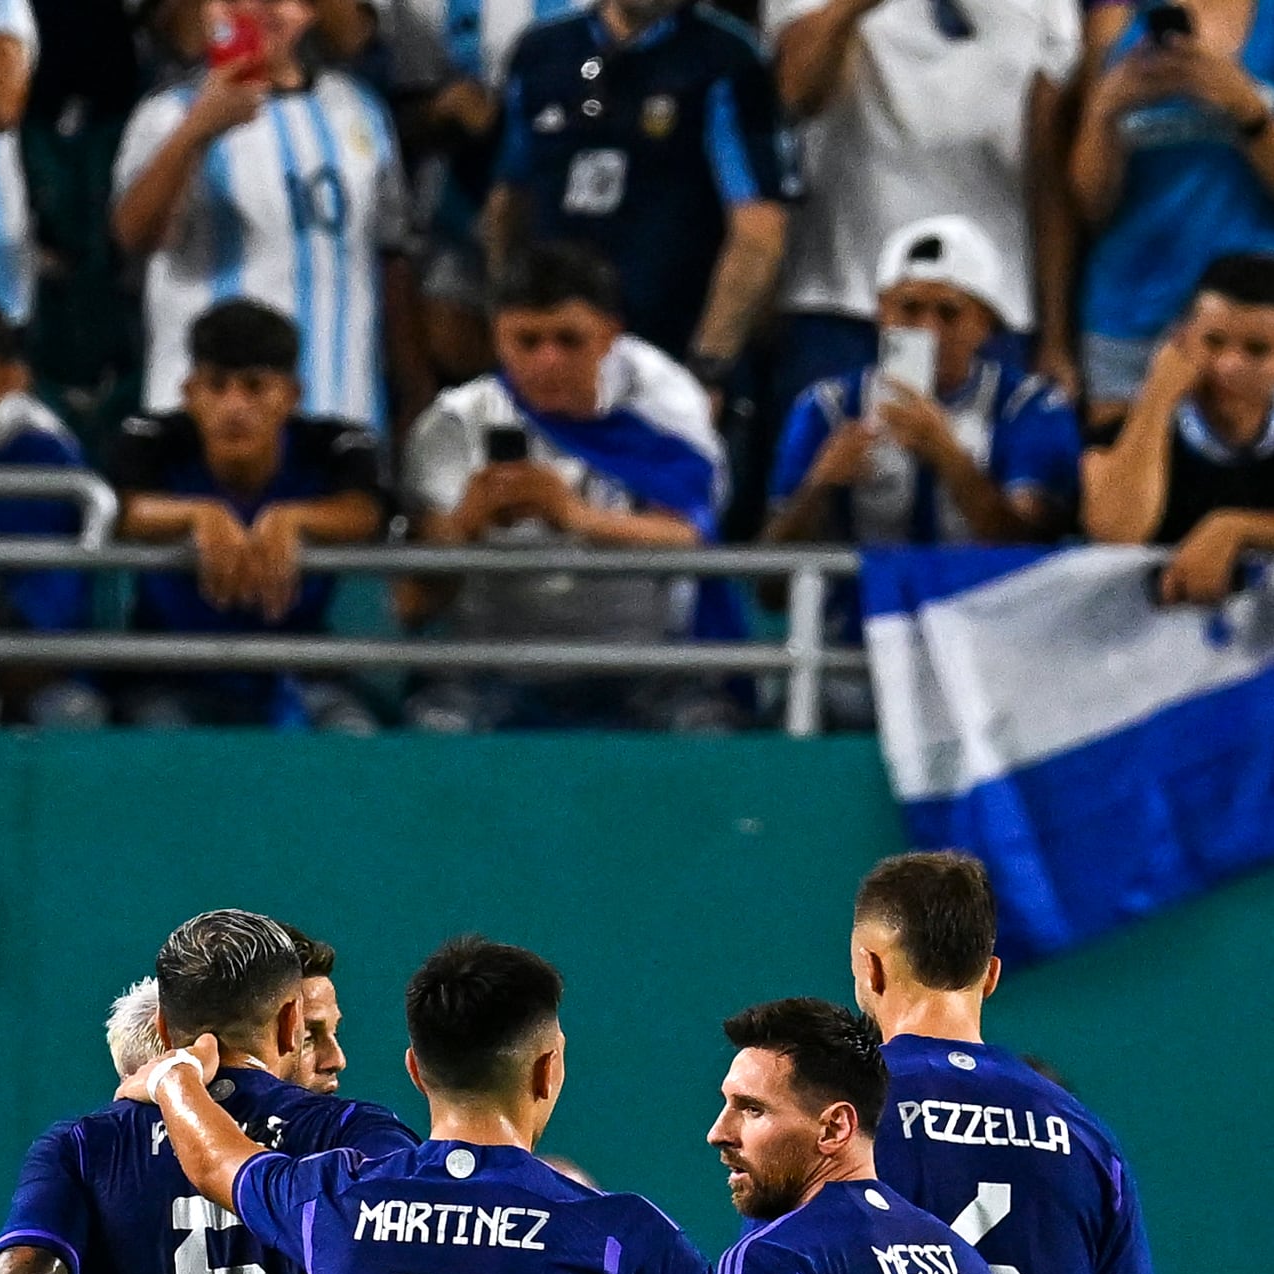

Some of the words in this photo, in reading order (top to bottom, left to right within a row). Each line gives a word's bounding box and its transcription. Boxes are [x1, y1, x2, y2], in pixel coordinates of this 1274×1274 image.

[285, 164, 345, 236] 10
[898, 1100, 1070, 1154] PEZZELLA
[354, 1199, 551, 1251] MARTINEZ
